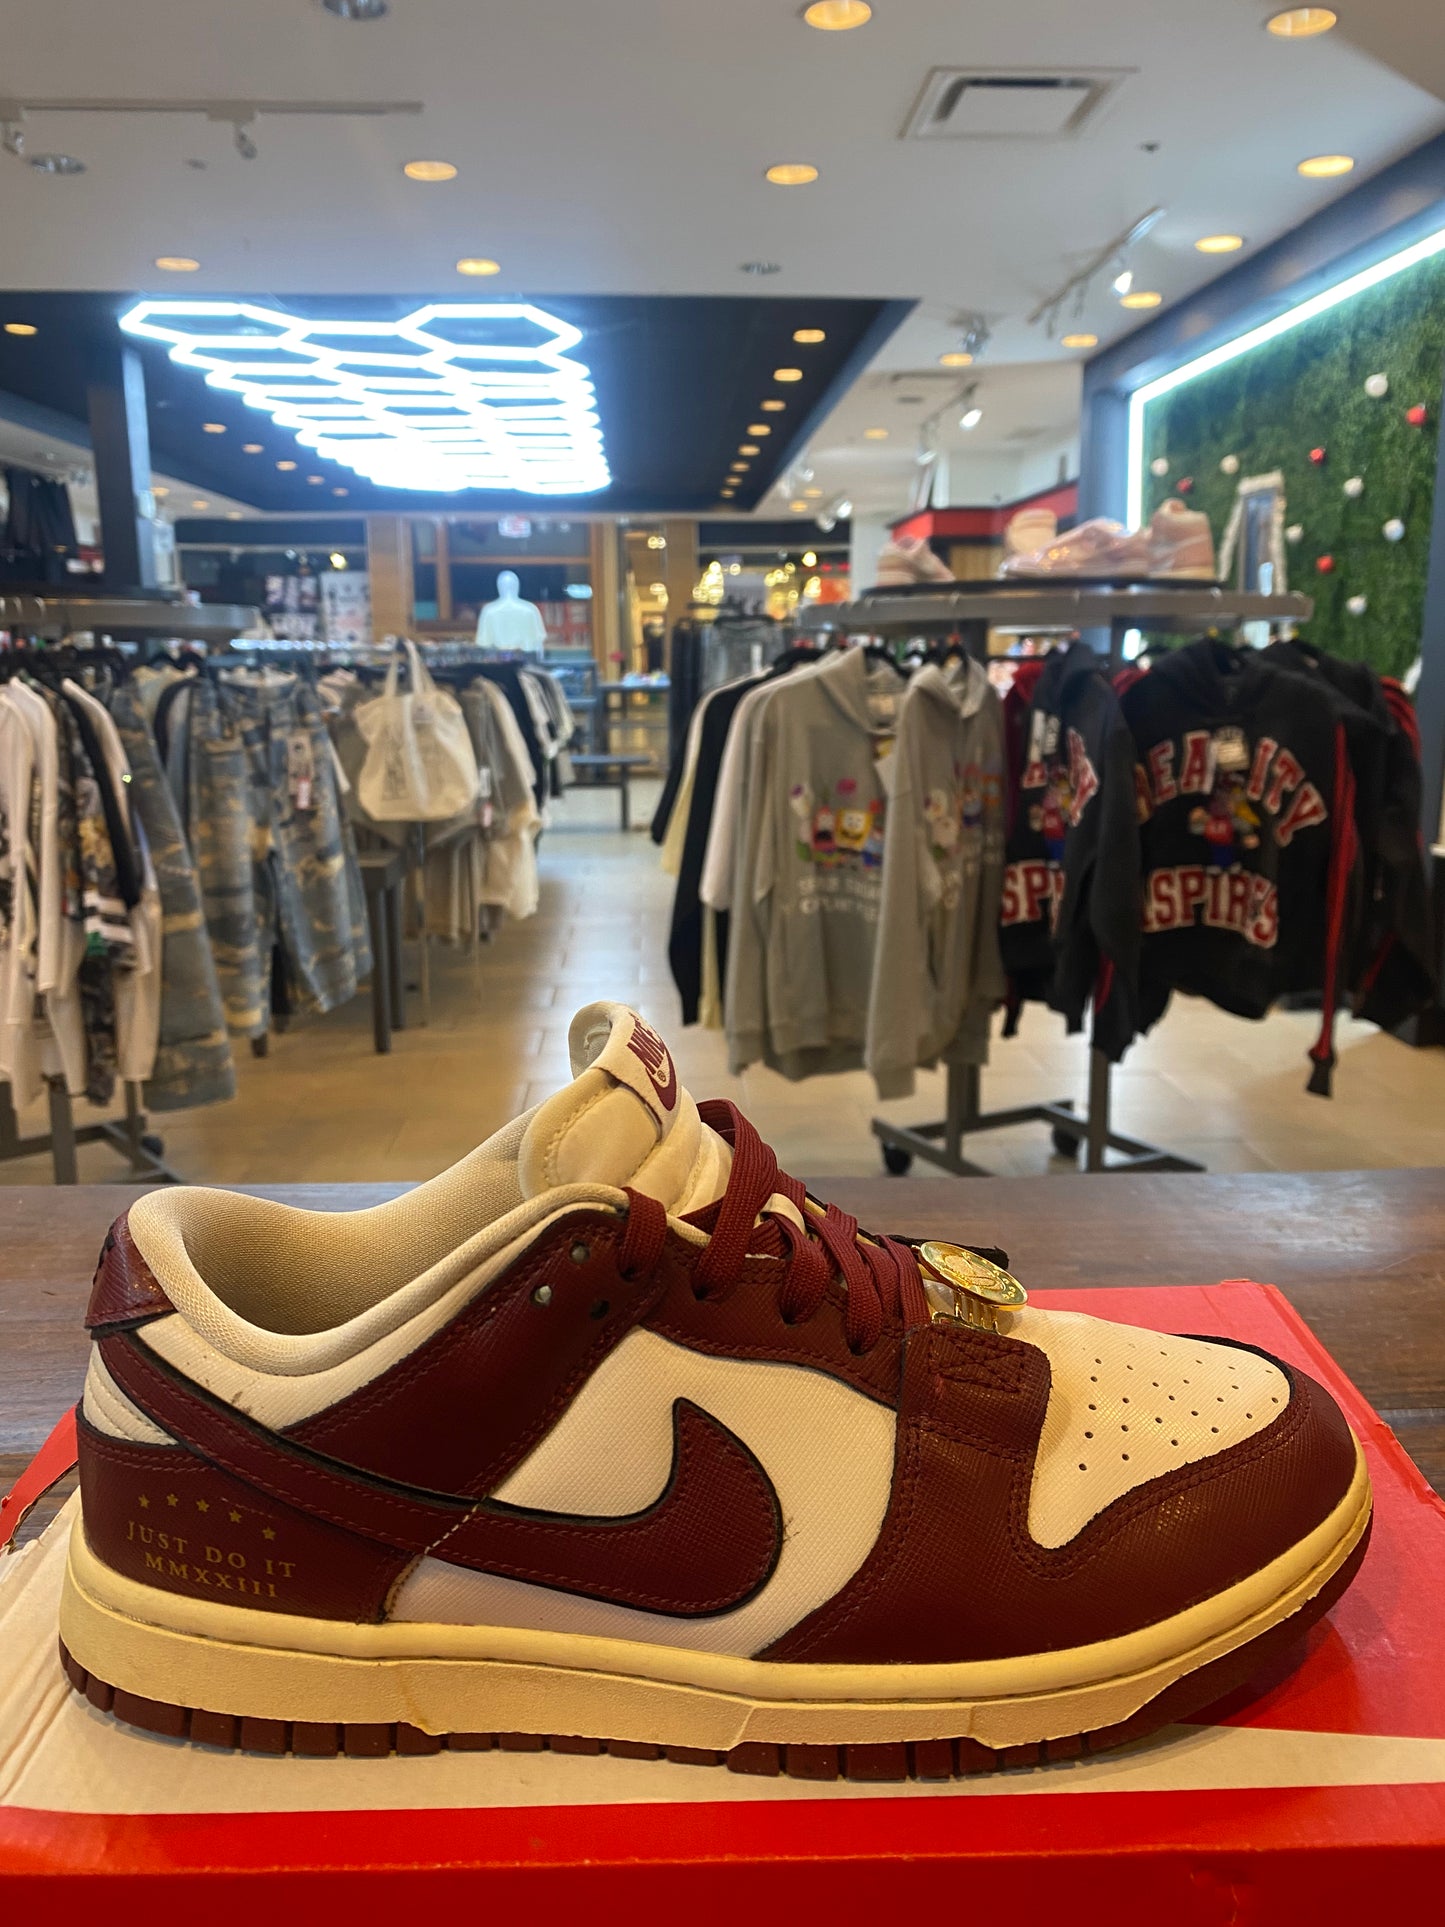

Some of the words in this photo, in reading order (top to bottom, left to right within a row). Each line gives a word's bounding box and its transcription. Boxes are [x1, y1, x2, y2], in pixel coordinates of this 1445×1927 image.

[127, 1520, 189, 1555] JUST
[205, 1546, 247, 1570] DO
[265, 1559, 297, 1579] IT
[145, 1551, 280, 1599] MMXXIII
